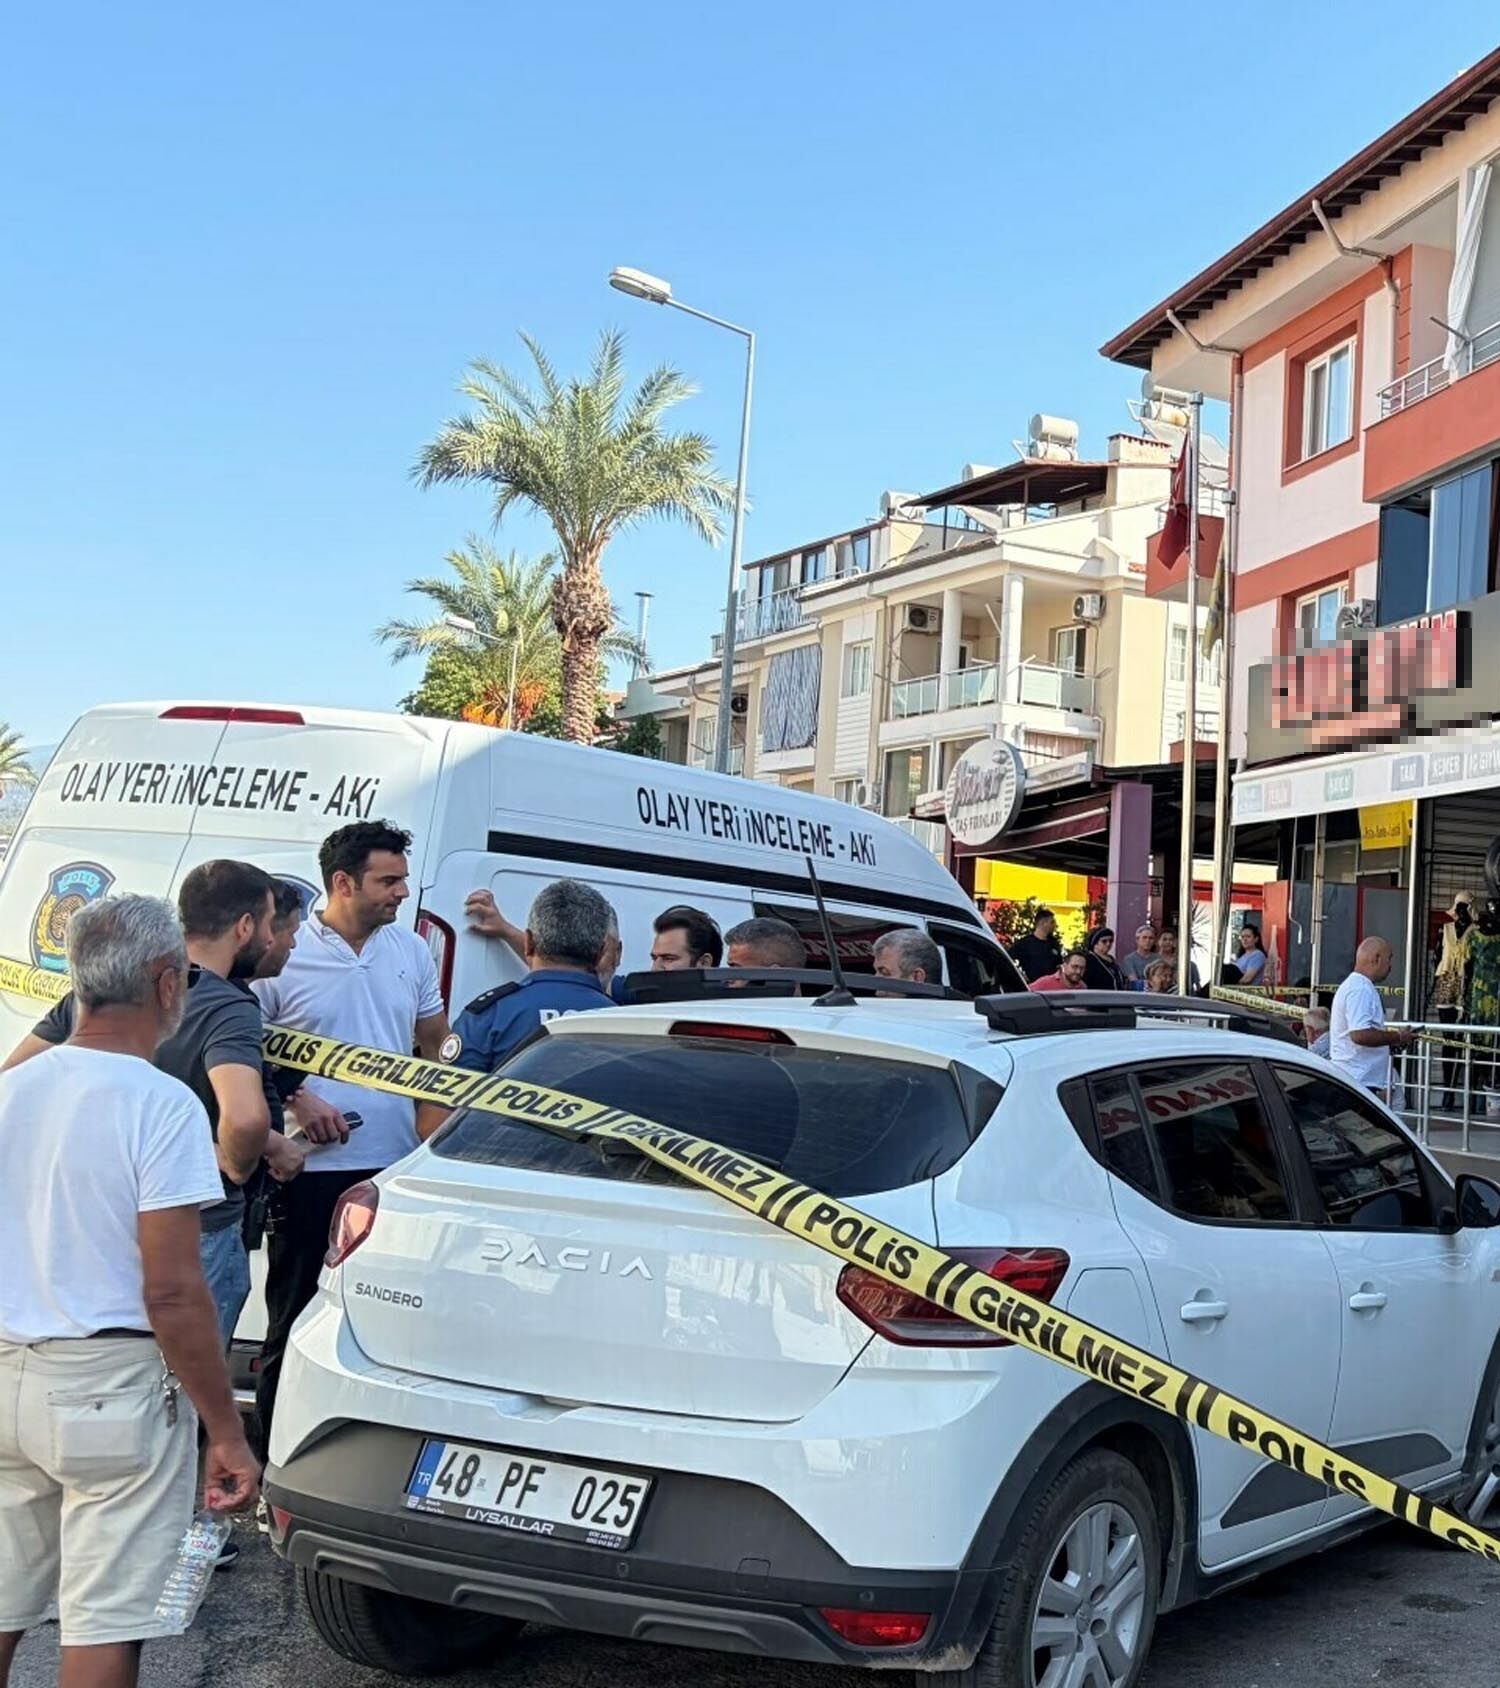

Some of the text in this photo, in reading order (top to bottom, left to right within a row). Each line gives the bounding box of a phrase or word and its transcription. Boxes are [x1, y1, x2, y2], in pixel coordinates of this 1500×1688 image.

[61, 763, 121, 802] OLAY
[637, 787, 690, 832] OLAY
[481, 1237, 653, 1280] DACIA
[355, 1282, 423, 1308] SANDERO
[417, 1471, 432, 1486] TR
[436, 1451, 641, 1529] 48 PF 025
[465, 1507, 555, 1536] UYSALLAR
